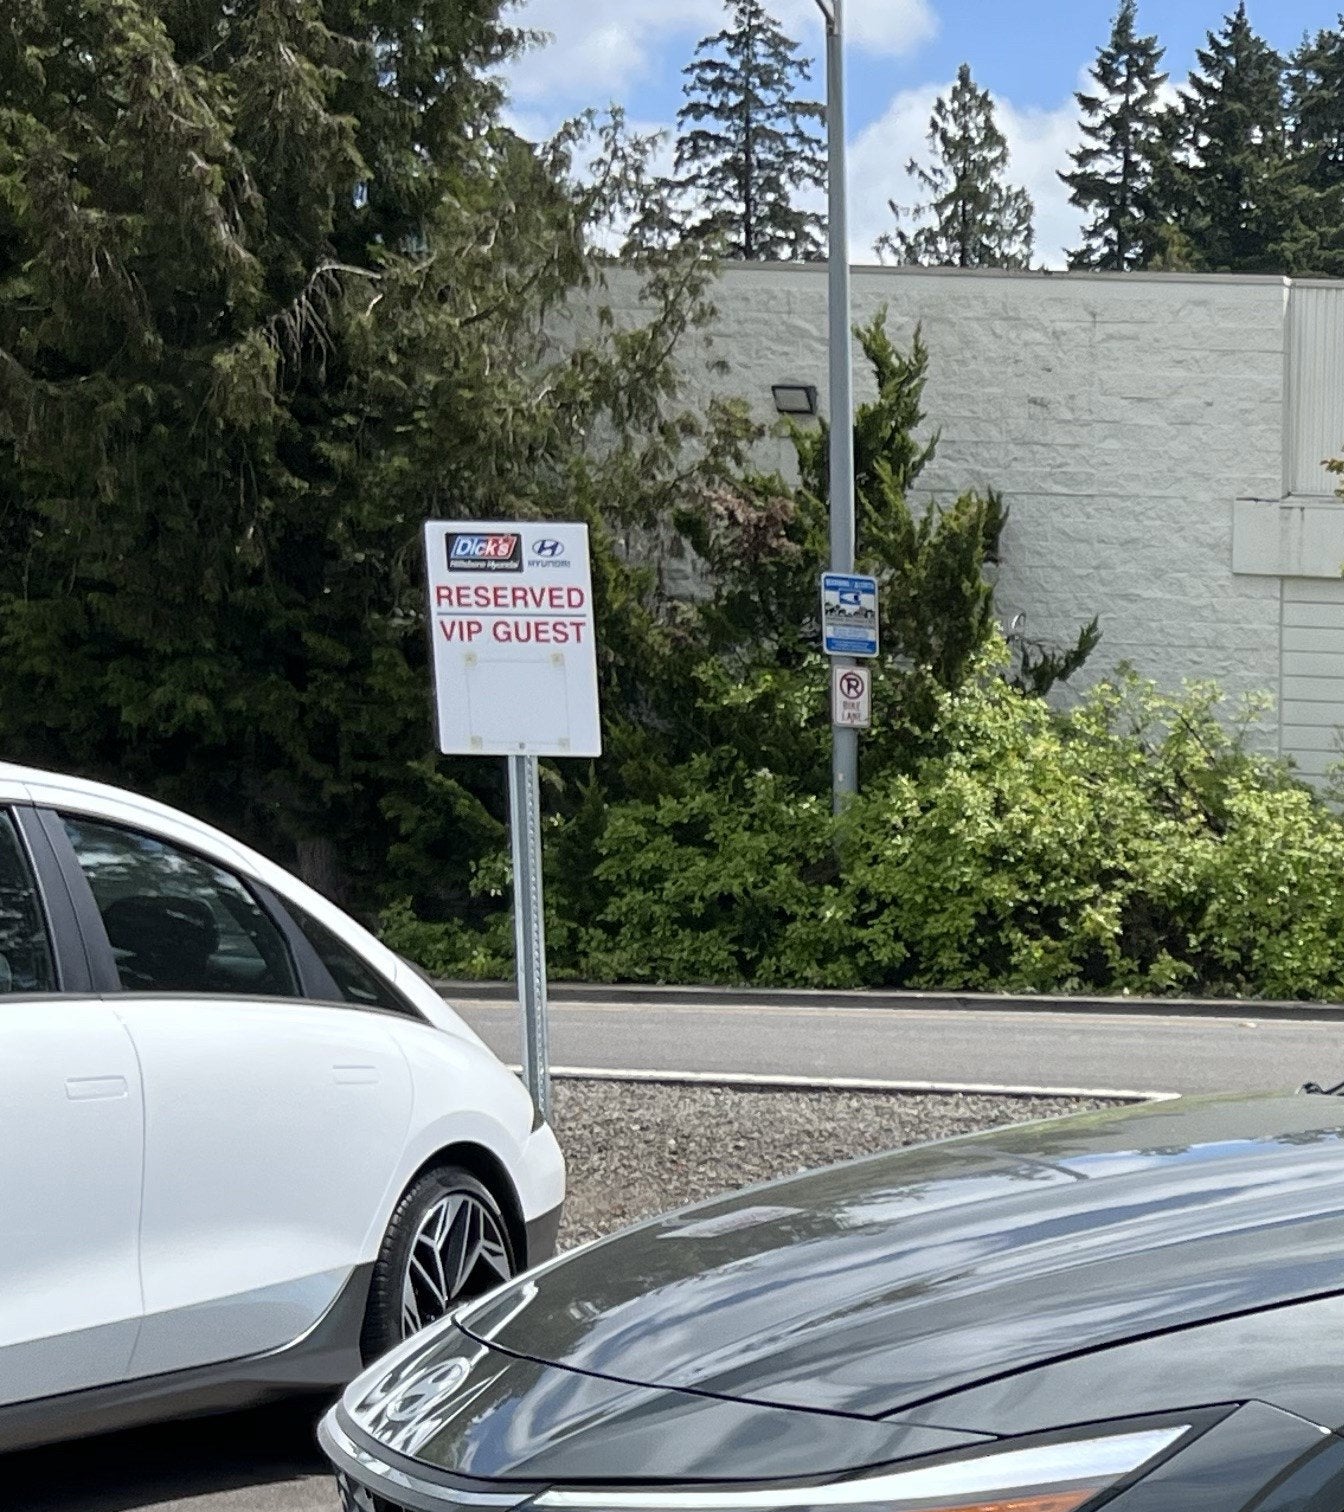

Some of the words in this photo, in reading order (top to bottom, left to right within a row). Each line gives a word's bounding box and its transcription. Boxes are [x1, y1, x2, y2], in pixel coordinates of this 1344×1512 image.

[436, 585, 585, 609] RESERVED
[440, 620, 483, 643] VIP
[492, 620, 586, 644] GUEST
